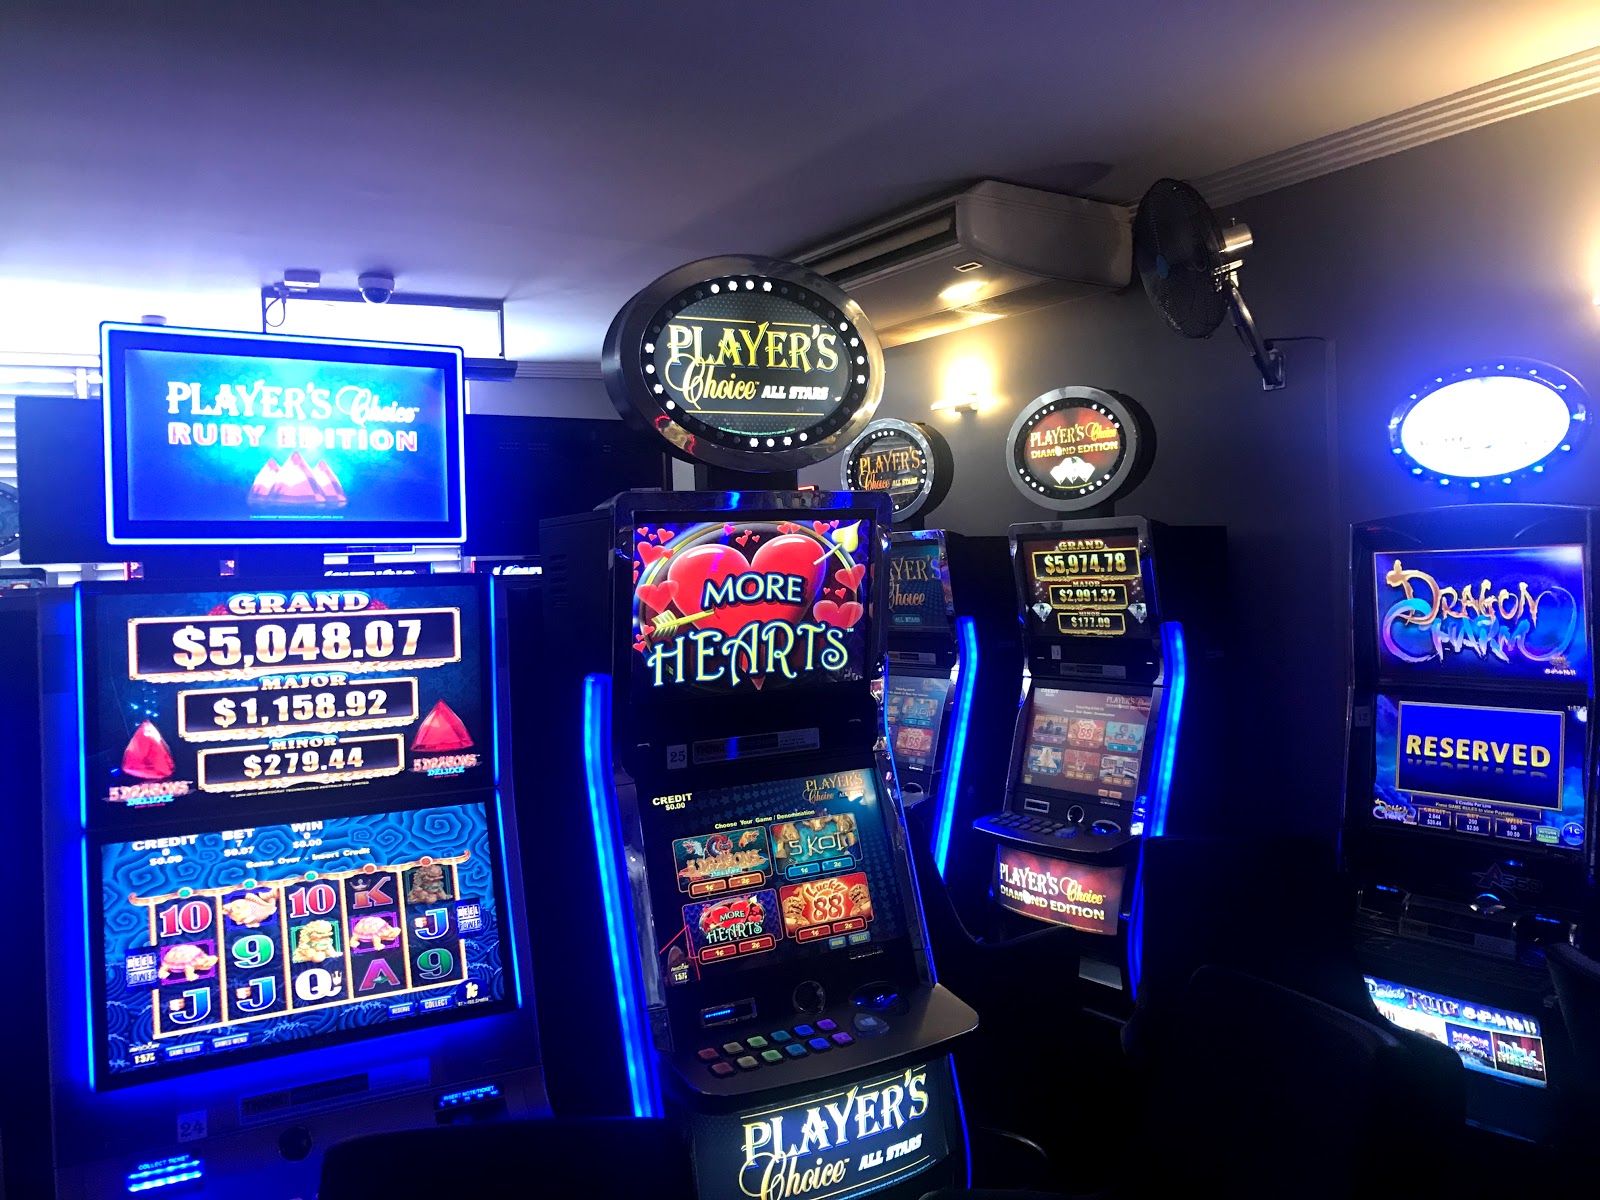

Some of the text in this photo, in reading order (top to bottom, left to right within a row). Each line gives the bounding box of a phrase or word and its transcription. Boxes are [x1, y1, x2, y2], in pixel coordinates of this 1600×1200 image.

[667, 322, 839, 373] PLAYER'S
[665, 352, 829, 410] Choice ALL STARS
[166, 379, 416, 428] PLAYER'S Choice
[168, 421, 418, 452] RUBY EDITION
[1030, 424, 1085, 448] PLAYER'S
[1078, 441, 1118, 454] EDITION
[860, 446, 921, 476] PLAYER'S
[858, 471, 890, 490] Choice
[1058, 540, 1104, 550] GRAND
[1044, 552, 1126, 575] $5,974.78
[704, 574, 803, 608] MORE
[1059, 588, 1116, 603] $2,991.32
[1386, 560, 1552, 628] DRAGON
[226, 591, 370, 616] GRAND
[1383, 598, 1545, 664] CHARM
[172, 619, 421, 670] $5,048.07
[647, 621, 851, 687] HEARTS
[260, 673, 348, 691] MAJOR
[213, 690, 388, 727] $1,158.92
[270, 735, 338, 751] MINOR
[1406, 734, 1550, 768] RESERVED
[244, 746, 364, 778] $279.44
[422, 754, 477, 770] DRAGONS
[670, 751, 686, 762] 25
[427, 766, 465, 776] DELUXE
[806, 772, 862, 792] PLAYER'S
[652, 793, 692, 806] CREDIT
[665, 802, 686, 811] $0.00
[802, 790, 834, 804] Choice
[291, 821, 324, 832] WIN
[714, 822, 737, 830] Choose
[740, 818, 753, 826] Your
[776, 809, 815, 820] Denomination
[132, 834, 198, 851] CREDIT
[222, 828, 255, 840] BET
[236, 840, 243, 848] 7
[292, 839, 322, 849] $0.00
[304, 832, 311, 840] 0
[789, 833, 843, 856] 5 KOI
[162, 848, 170, 856] 0
[224, 846, 255, 857] $0.07
[246, 860, 274, 868] Game
[278, 856, 302, 865] Over
[312, 852, 340, 861] Insert
[342, 847, 370, 858] Credit
[353, 876, 393, 910] K
[805, 878, 848, 898] Lucky
[1000, 863, 1103, 904] PLAYER'S Choice
[289, 884, 337, 918] 10
[813, 893, 844, 921] 88
[1050, 900, 1104, 920] EDITION
[160, 901, 212, 938] 10
[416, 908, 450, 940] J
[720, 910, 745, 922] MORE
[706, 922, 763, 944] HEARTS
[232, 935, 274, 968] 9
[359, 958, 400, 991] A
[417, 948, 454, 980] 9
[236, 976, 276, 1012] J
[295, 968, 342, 1002] Q
[169, 987, 210, 1024] J
[425, 999, 448, 1010] COLLECT
[741, 1068, 928, 1168] PLAYER'S
[181, 1122, 206, 1138] 24
[138, 1159, 166, 1170] COLLECT
[738, 1152, 846, 1200] Choice
[858, 1150, 883, 1171] ALL
[886, 1133, 922, 1161] STARS
